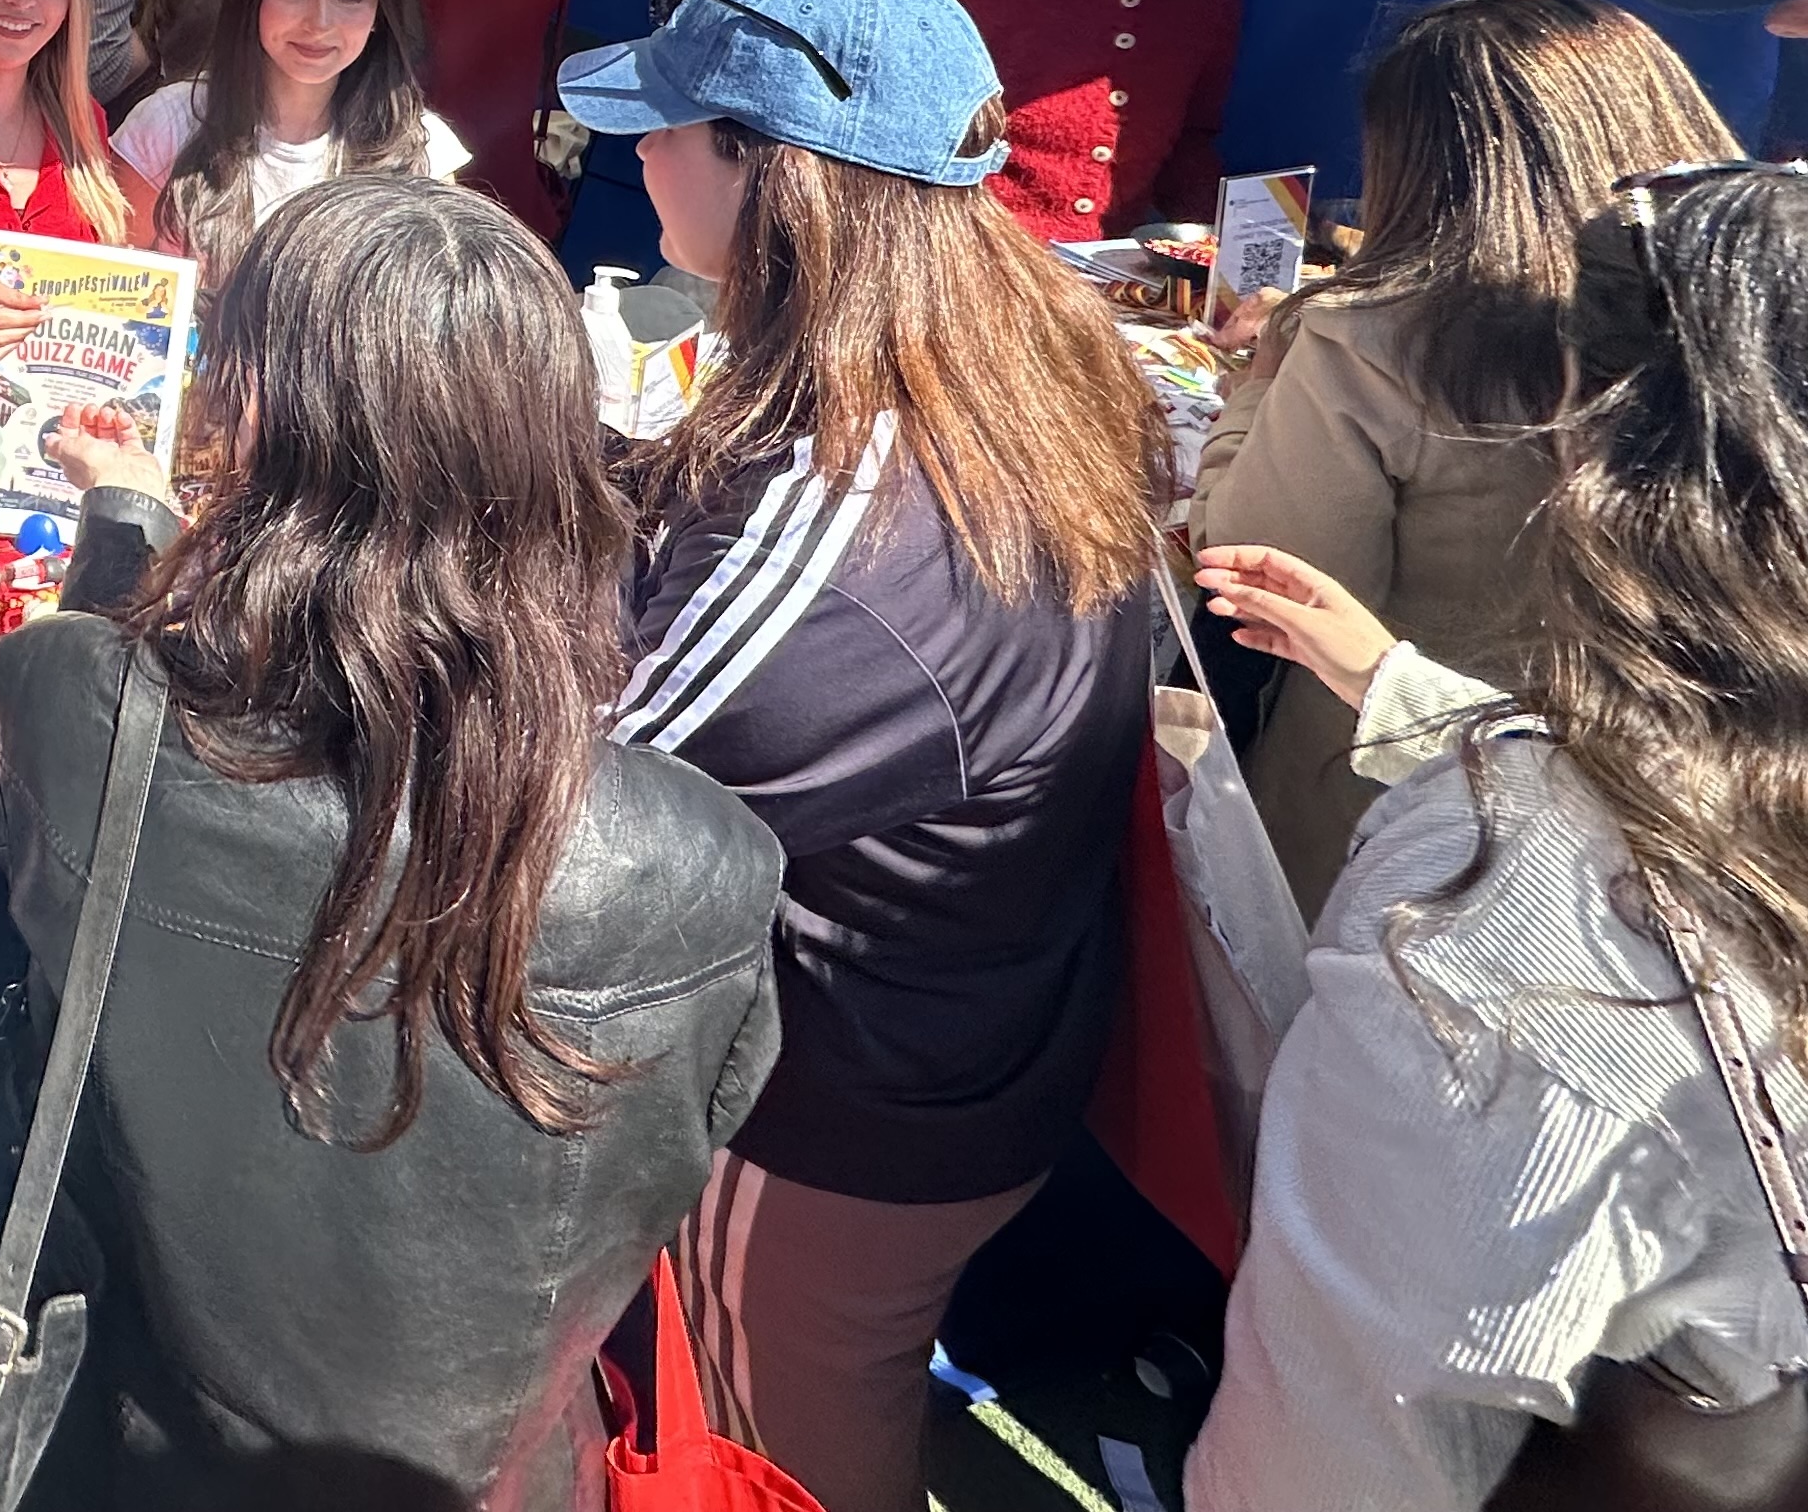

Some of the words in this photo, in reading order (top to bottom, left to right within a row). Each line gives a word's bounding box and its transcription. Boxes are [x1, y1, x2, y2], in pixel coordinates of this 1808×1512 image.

[32, 317, 136, 358] ULGARIAN
[16, 340, 75, 364] QUIZZ
[81, 349, 138, 383] GAME
